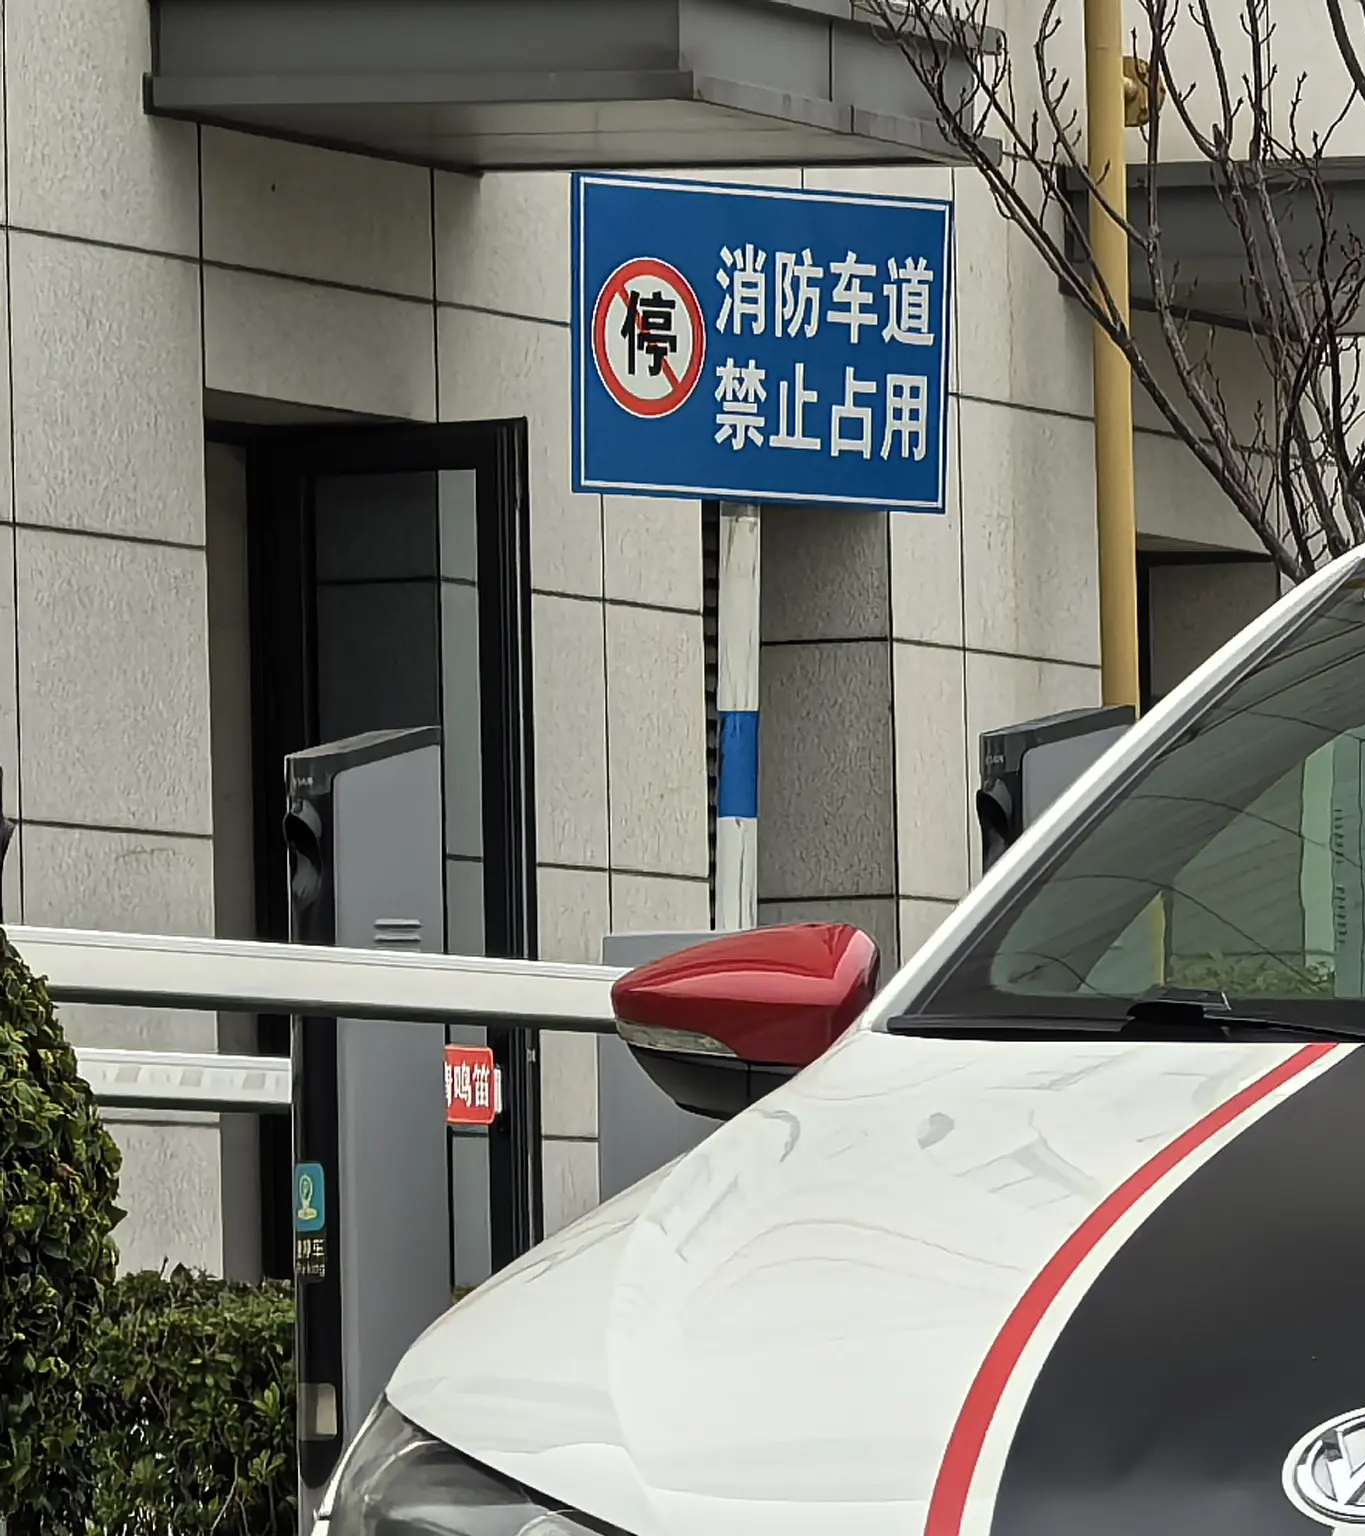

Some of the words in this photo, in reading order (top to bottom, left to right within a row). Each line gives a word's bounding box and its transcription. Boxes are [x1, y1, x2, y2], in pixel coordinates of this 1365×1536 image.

[621, 290, 678, 376] 停
[715, 243, 934, 346] 消防车道
[713, 357, 929, 461] 禁止占用
